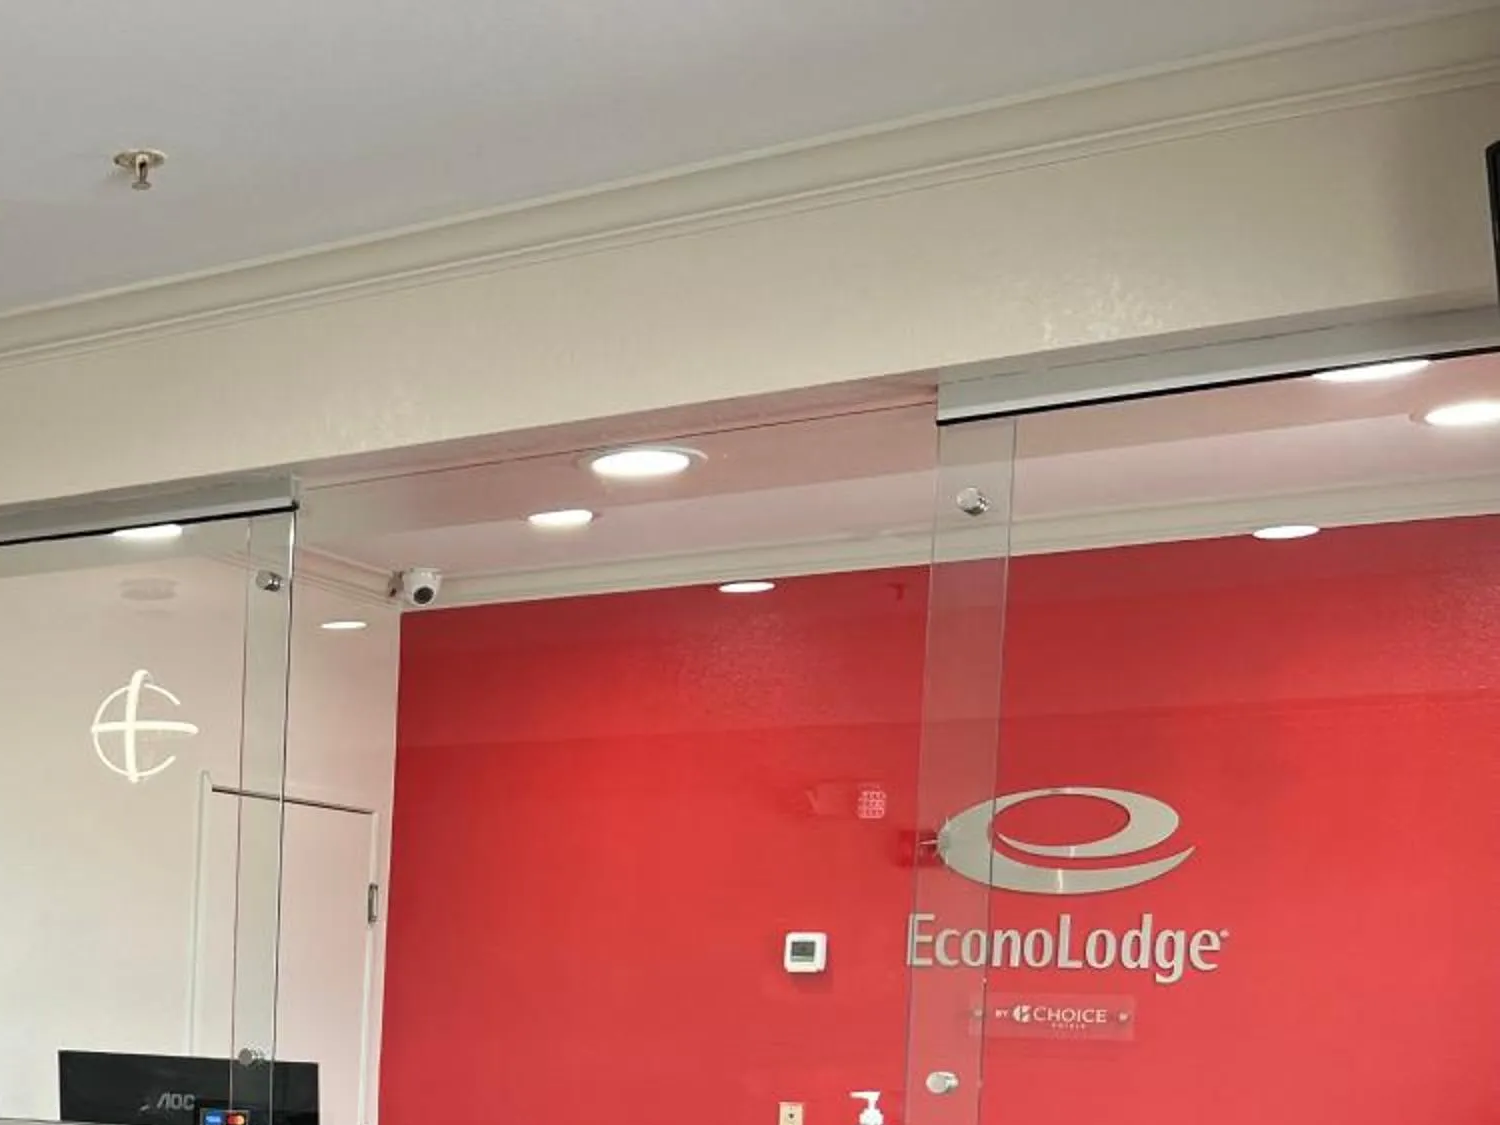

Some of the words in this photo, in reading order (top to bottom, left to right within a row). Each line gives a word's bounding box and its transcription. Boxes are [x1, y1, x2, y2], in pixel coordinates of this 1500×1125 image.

[906, 912, 1221, 985] EconoLodge
[1032, 1006, 1109, 1024] CHOICE
[156, 1092, 196, 1111] AOC
